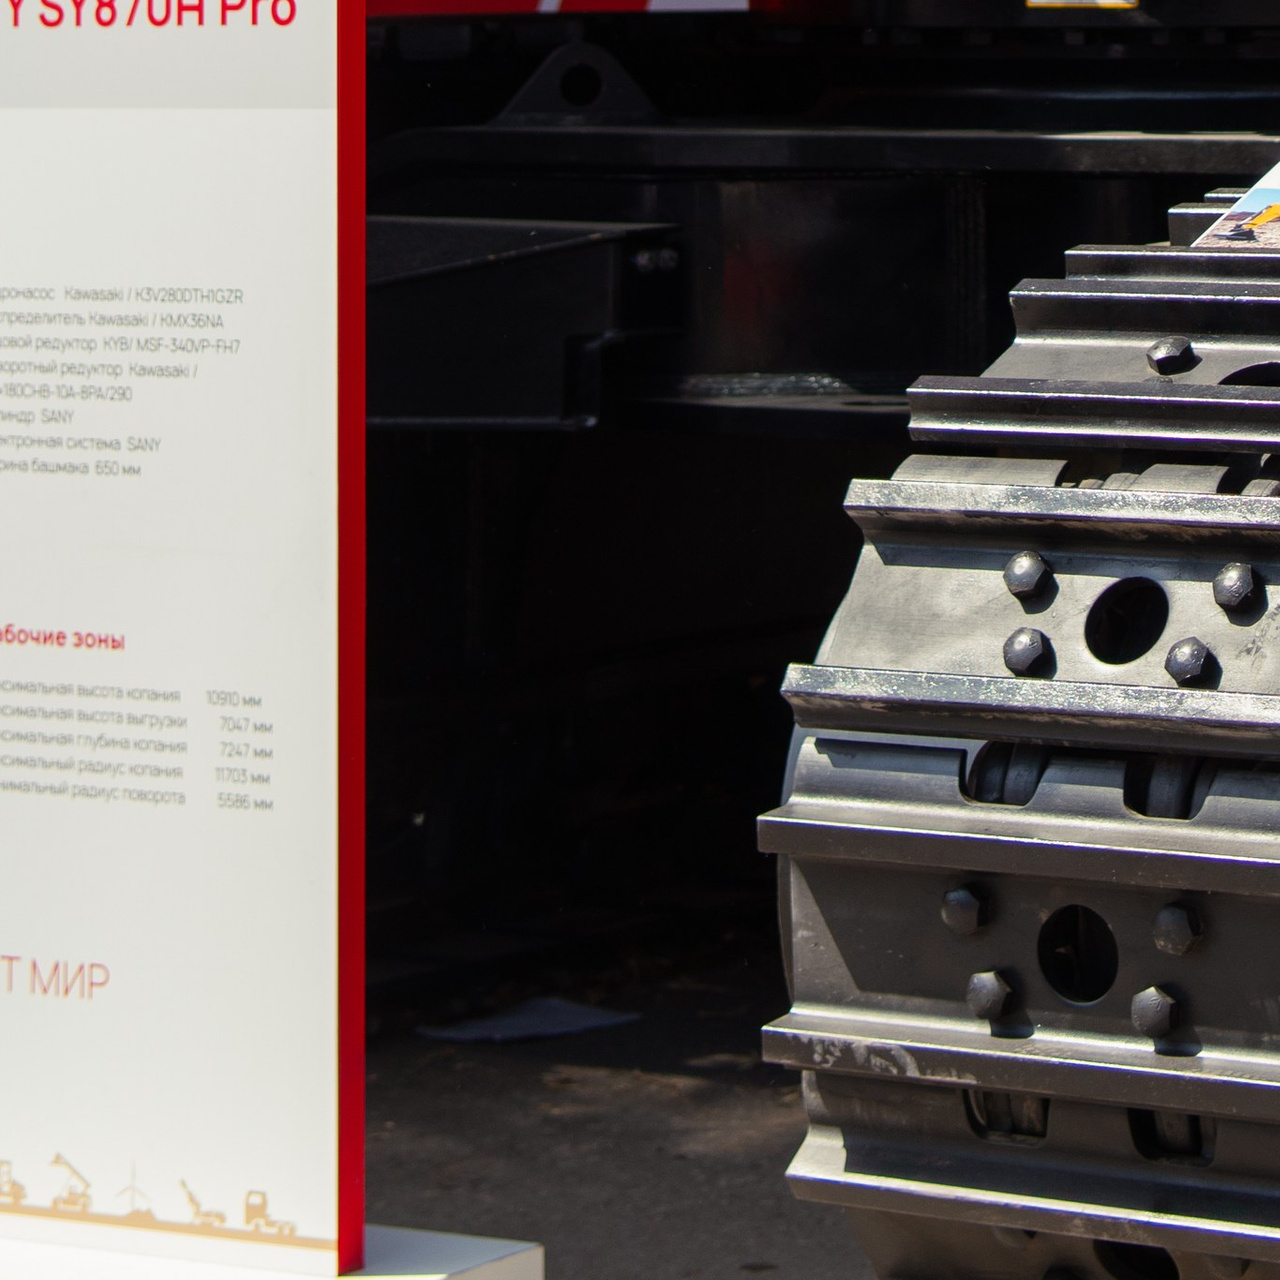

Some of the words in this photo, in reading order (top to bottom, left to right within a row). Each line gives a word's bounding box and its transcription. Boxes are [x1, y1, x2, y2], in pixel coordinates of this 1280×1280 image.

[64, 287, 124, 302] Kawasaki
[89, 312, 149, 327] Kawasaki
[160, 313, 224, 328] KMX36NA
[35, 338, 97, 355] редуктор
[61, 362, 123, 379] редуктор
[129, 363, 189, 378] Kawasaki
[41, 409, 74, 424] SANY
[66, 438, 121, 452] система
[127, 437, 161, 452] SANY
[32, 458, 89, 474] башмака
[95, 460, 119, 476] 650
[122, 463, 141, 476] мм
[73, 631, 125, 650] зоны
[77, 684, 124, 699] высота
[126, 688, 181, 703] копания
[206, 689, 239, 706] 10910
[242, 693, 262, 708] мм
[77, 709, 124, 724] высота
[126, 713, 187, 730] выгрузки
[219, 715, 250, 732] 7047
[253, 719, 273, 734] мм
[77, 732, 130, 751] глубина
[133, 738, 187, 754] копания
[219, 741, 250, 757] 7247
[253, 745, 273, 760] мм
[77, 759, 126, 777] радиус
[129, 763, 183, 779] копания
[215, 767, 248, 783] 11703
[251, 771, 270, 786] мм
[72, 784, 120, 802] радиус
[122, 789, 186, 806] поворота
[253, 797, 274, 812] мм
[30, 958, 110, 1000] МИР
